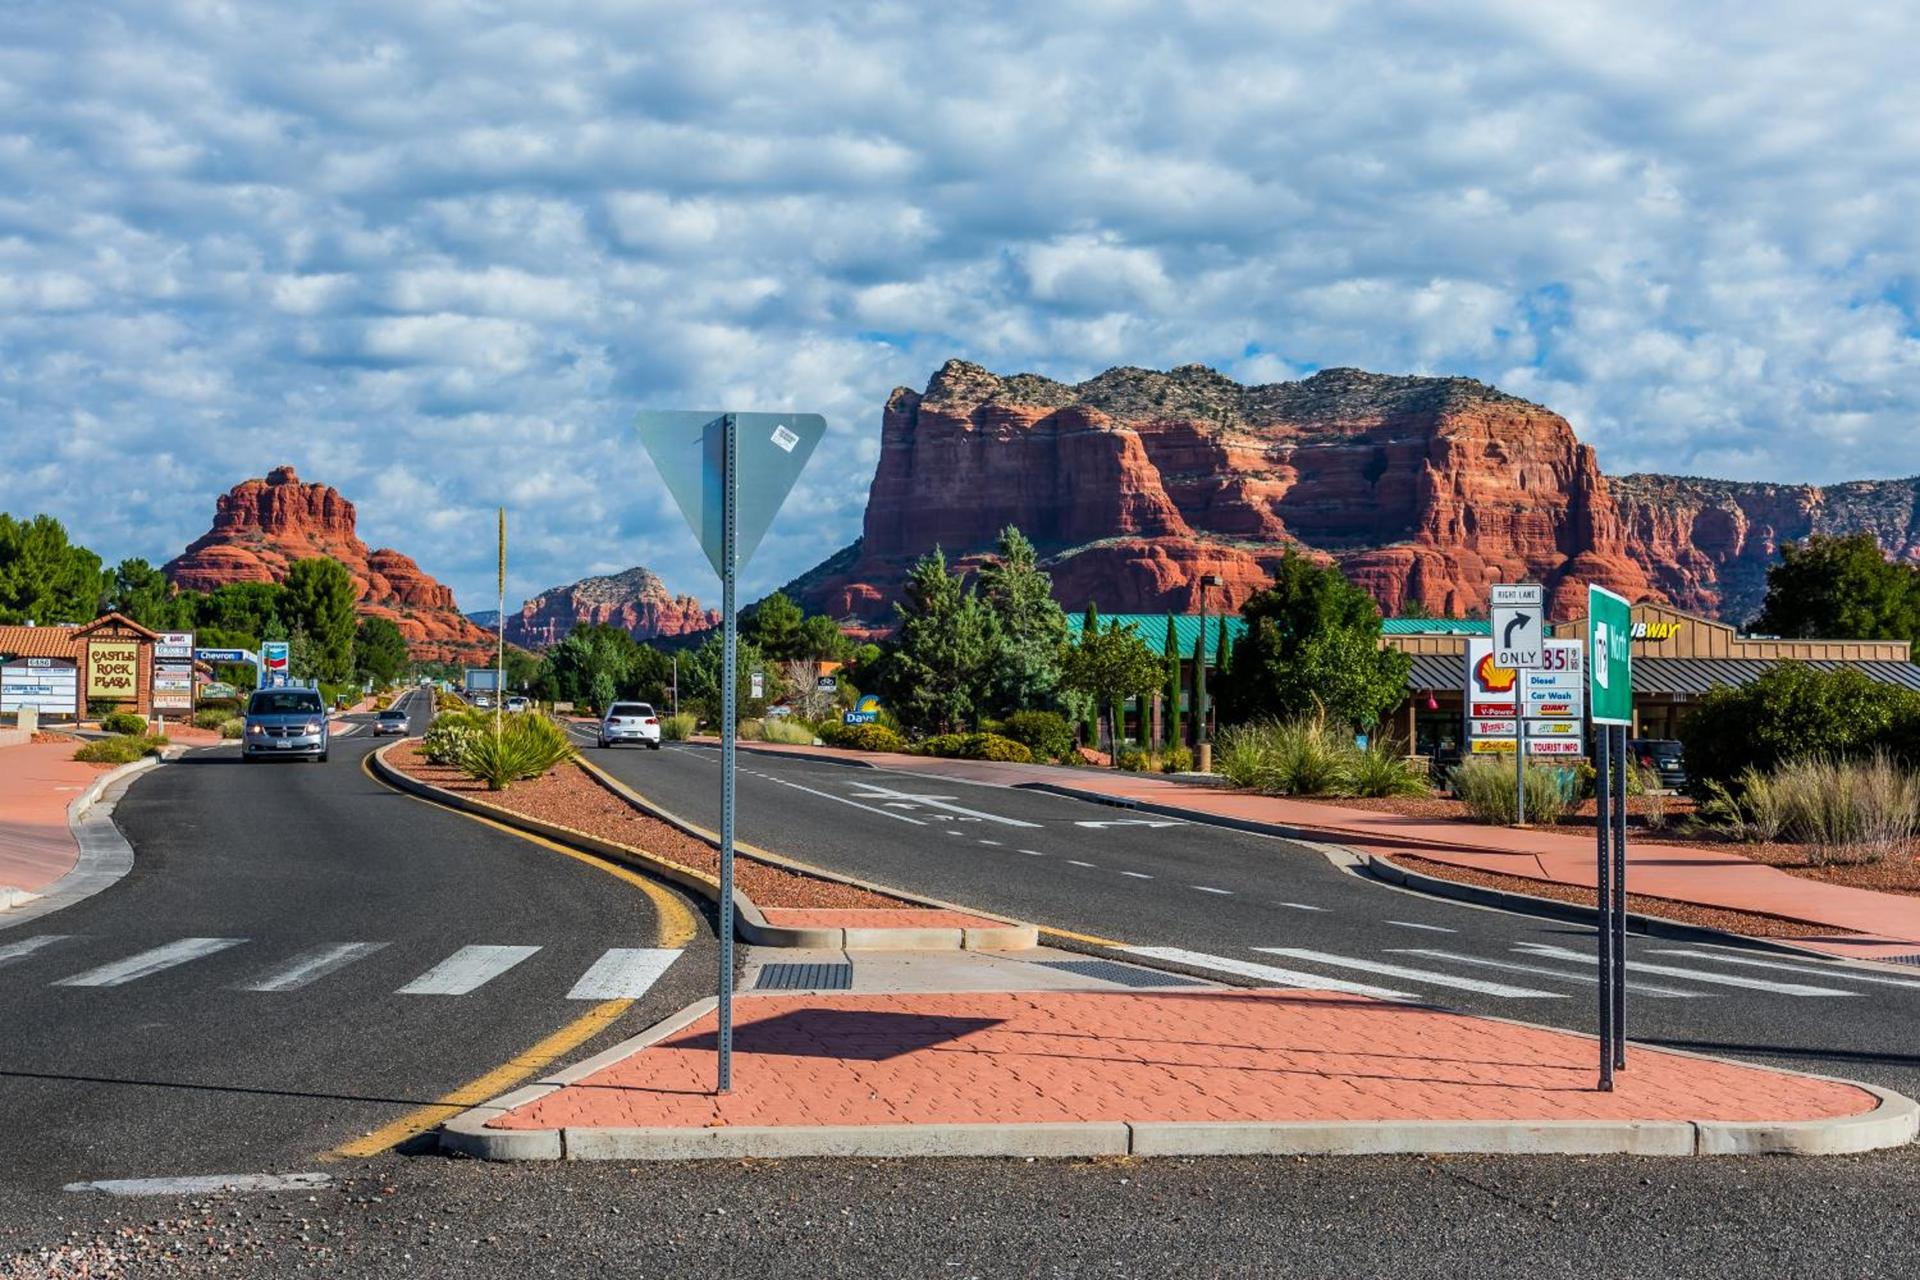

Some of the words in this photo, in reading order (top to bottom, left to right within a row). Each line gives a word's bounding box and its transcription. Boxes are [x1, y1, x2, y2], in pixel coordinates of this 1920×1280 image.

[1498, 590, 1516, 599] RIGHT
[1519, 590, 1536, 599] LANE
[1630, 623, 1680, 638] UBWAY
[1610, 624, 1626, 662] North
[92, 651, 135, 663] CASTLE
[201, 652, 235, 660] Chevron
[1500, 652, 1536, 664] ONLY
[97, 664, 133, 675] ROCK
[95, 677, 131, 689] PLAZA
[1531, 692, 1545, 700] Car
[1549, 692, 1571, 700] Wash
[847, 713, 874, 723] Days
[1534, 743, 1561, 752] TOURIST
[1563, 743, 1578, 752] INFO
